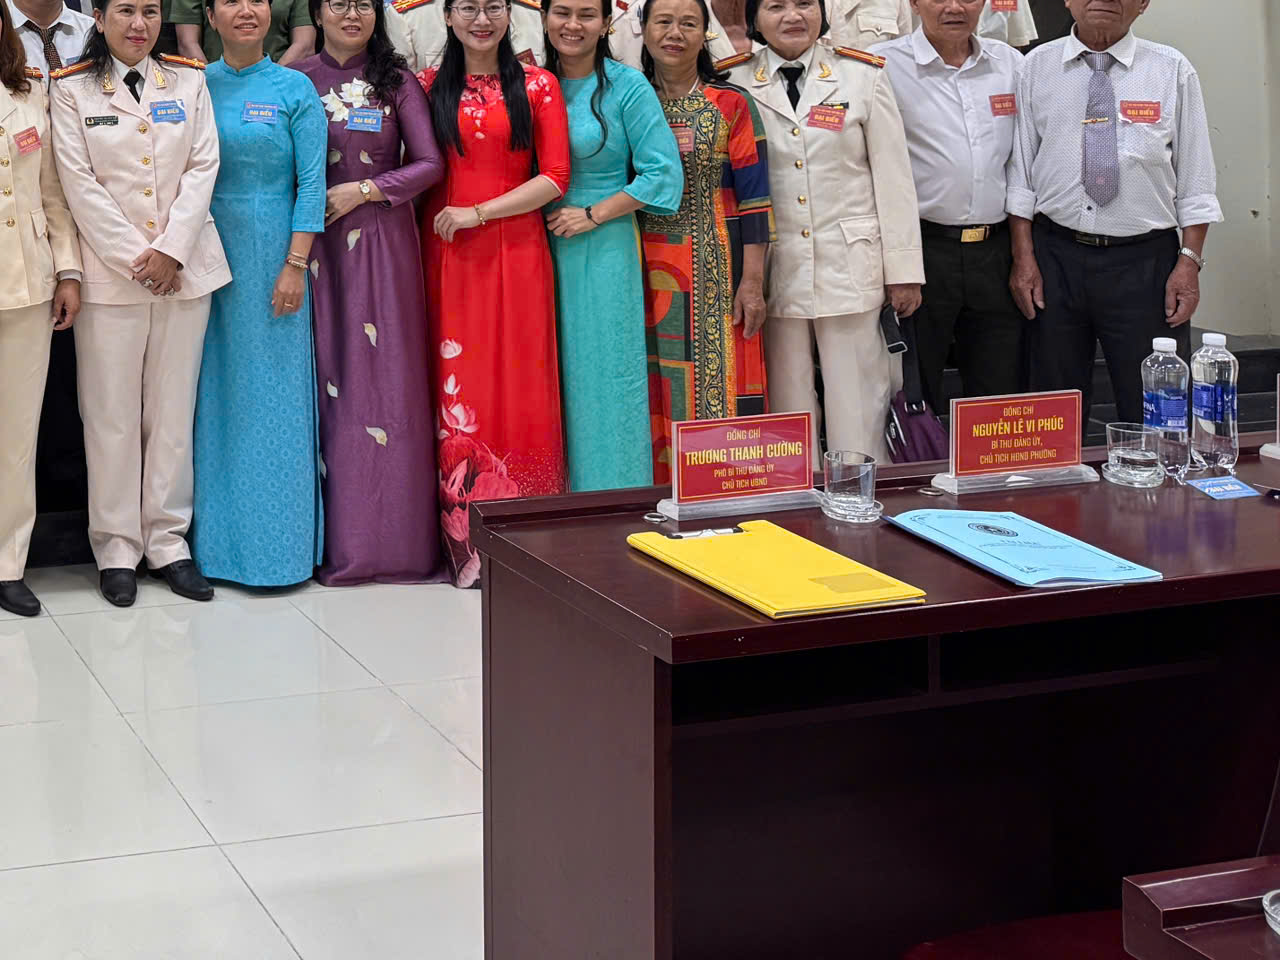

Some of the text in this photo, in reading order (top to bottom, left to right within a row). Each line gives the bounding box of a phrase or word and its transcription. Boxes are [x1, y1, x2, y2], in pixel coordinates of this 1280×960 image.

[973, 415, 1064, 437] NGUYỄN LÊ VI PHÚC
[686, 441, 802, 466] TRƯƠNG THANH CƯỜNG
